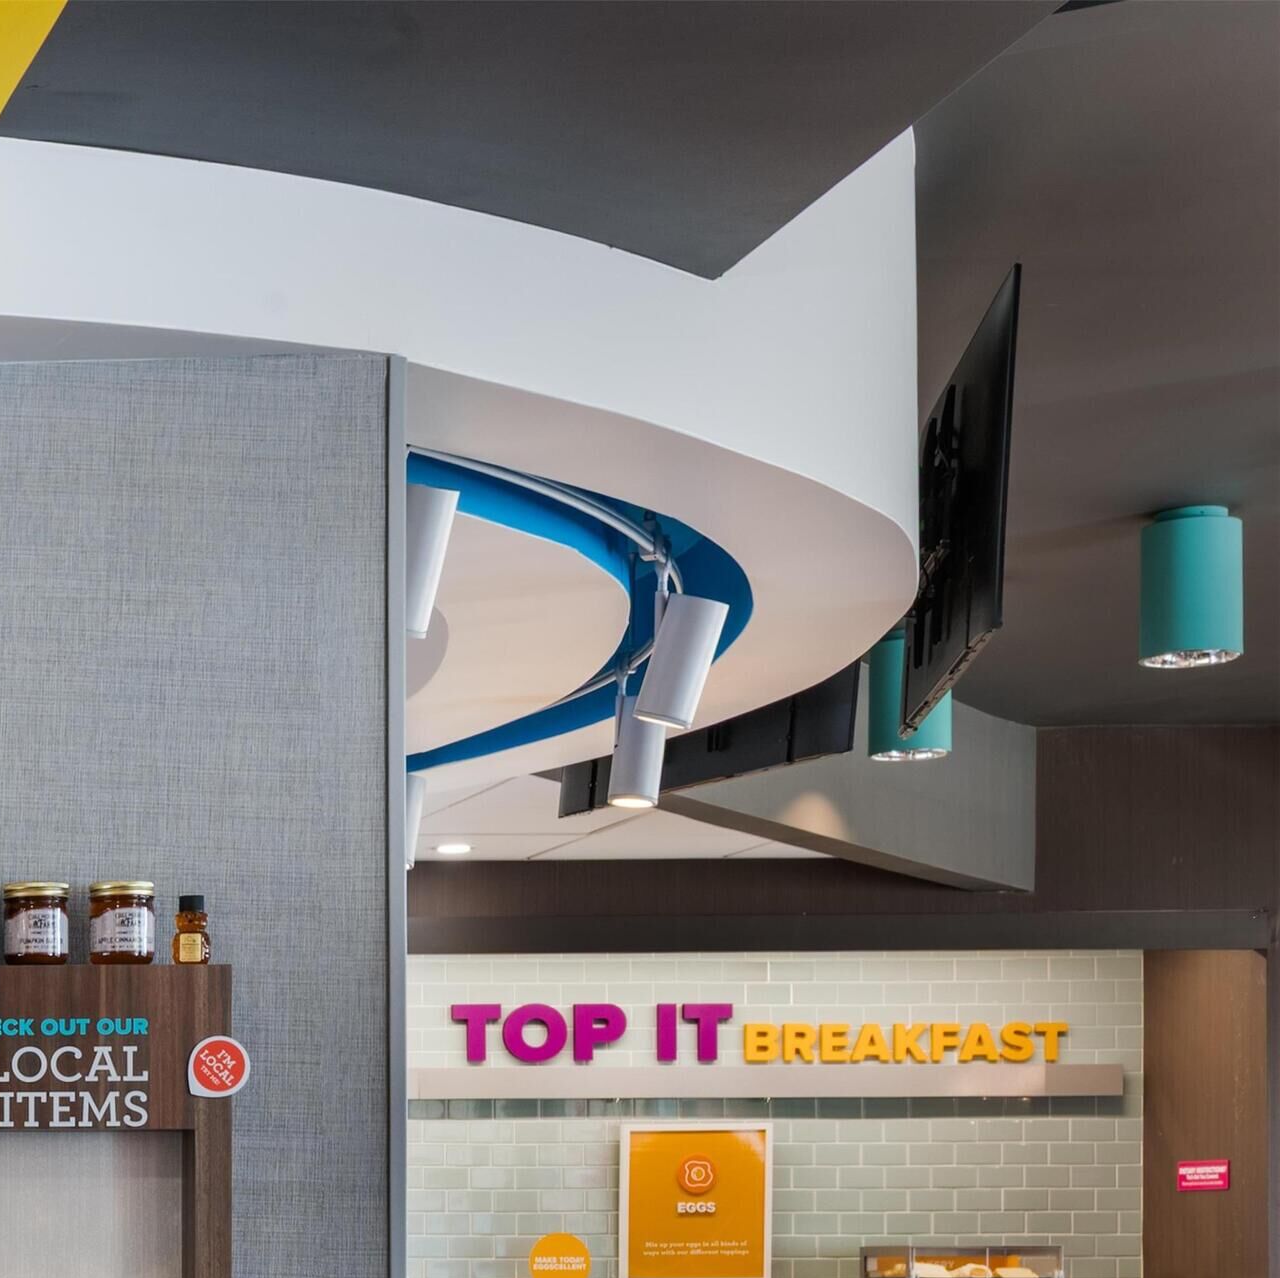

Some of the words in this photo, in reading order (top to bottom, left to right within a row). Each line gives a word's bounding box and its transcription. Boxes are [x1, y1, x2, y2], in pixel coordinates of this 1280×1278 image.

[40, 1018, 90, 1036] OUT
[96, 1018, 149, 1036] OUR
[450, 1003, 627, 1064] TOP
[656, 1003, 733, 1063] IT
[742, 1020, 1069, 1066] BREAKFAST
[200, 1049, 235, 1087] LOCAL
[217, 1049, 237, 1070] I'M
[677, 1201, 716, 1213] EGGS
[533, 1263, 586, 1271] EGGSCELLENT
[559, 1256, 585, 1264] TODAY
